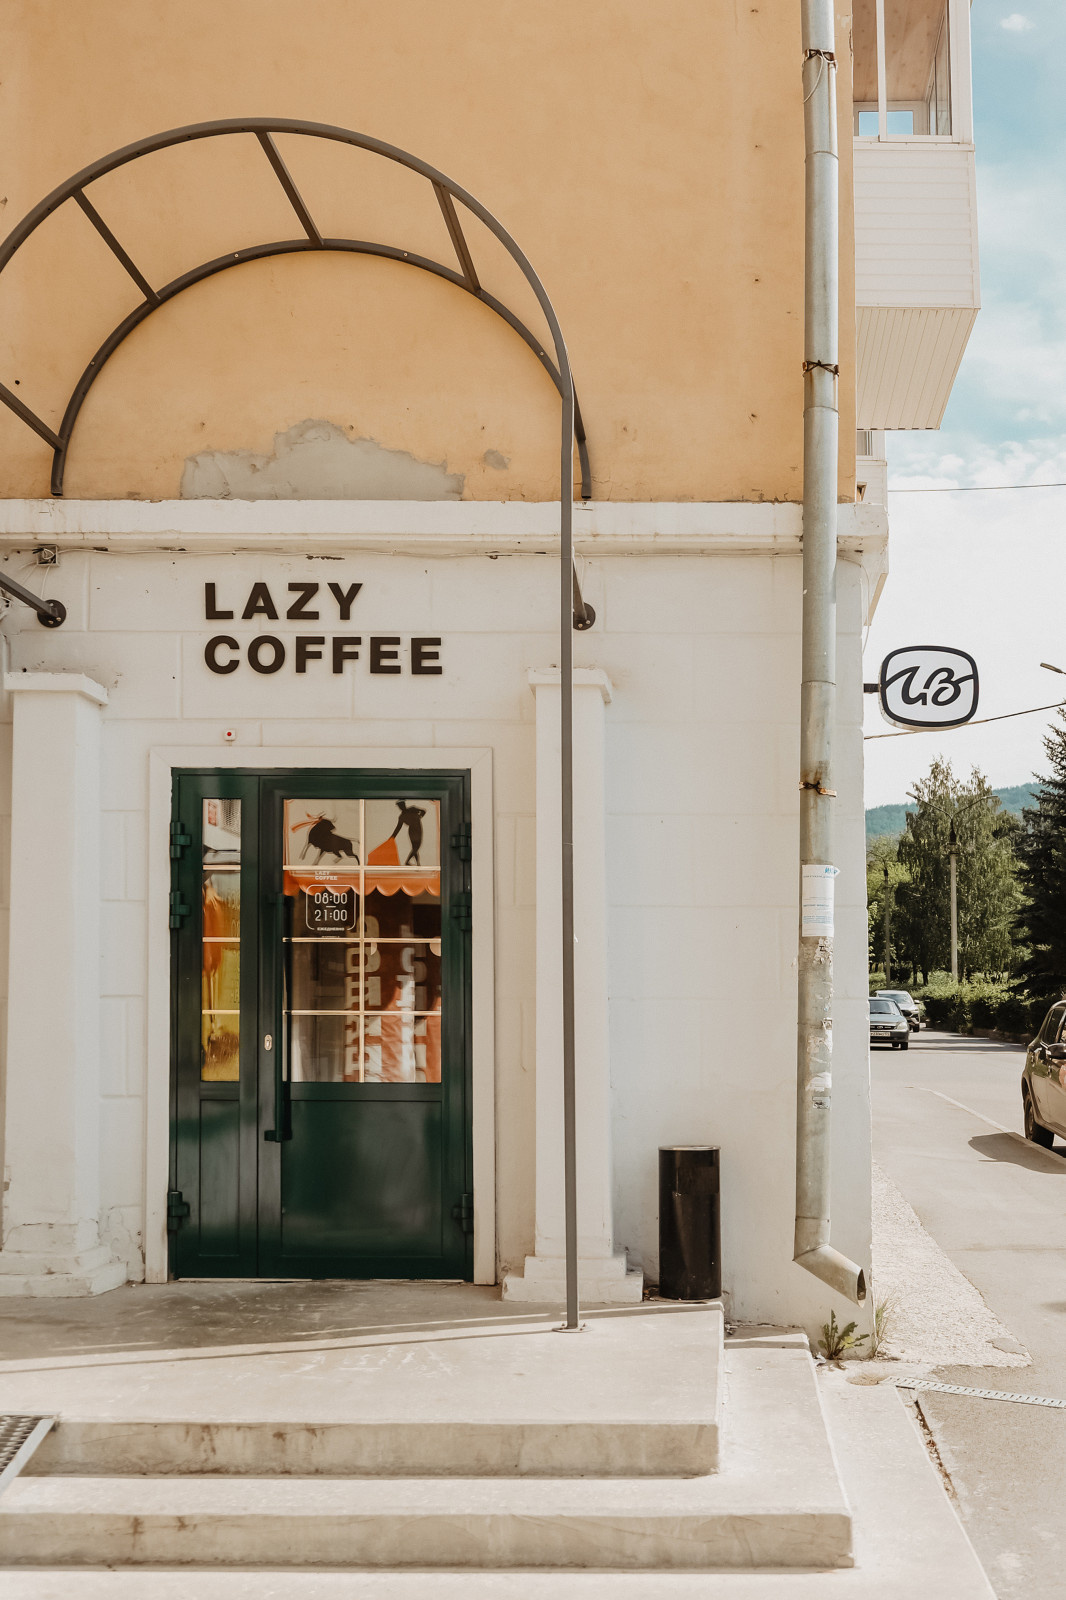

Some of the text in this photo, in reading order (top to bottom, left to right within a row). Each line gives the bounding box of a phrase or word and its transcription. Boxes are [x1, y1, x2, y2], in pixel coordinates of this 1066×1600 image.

[205, 582, 363, 621] LAZY
[204, 635, 443, 675] COFFEE
[314, 892, 348, 904] 08:00
[314, 909, 348, 922] 21:00
